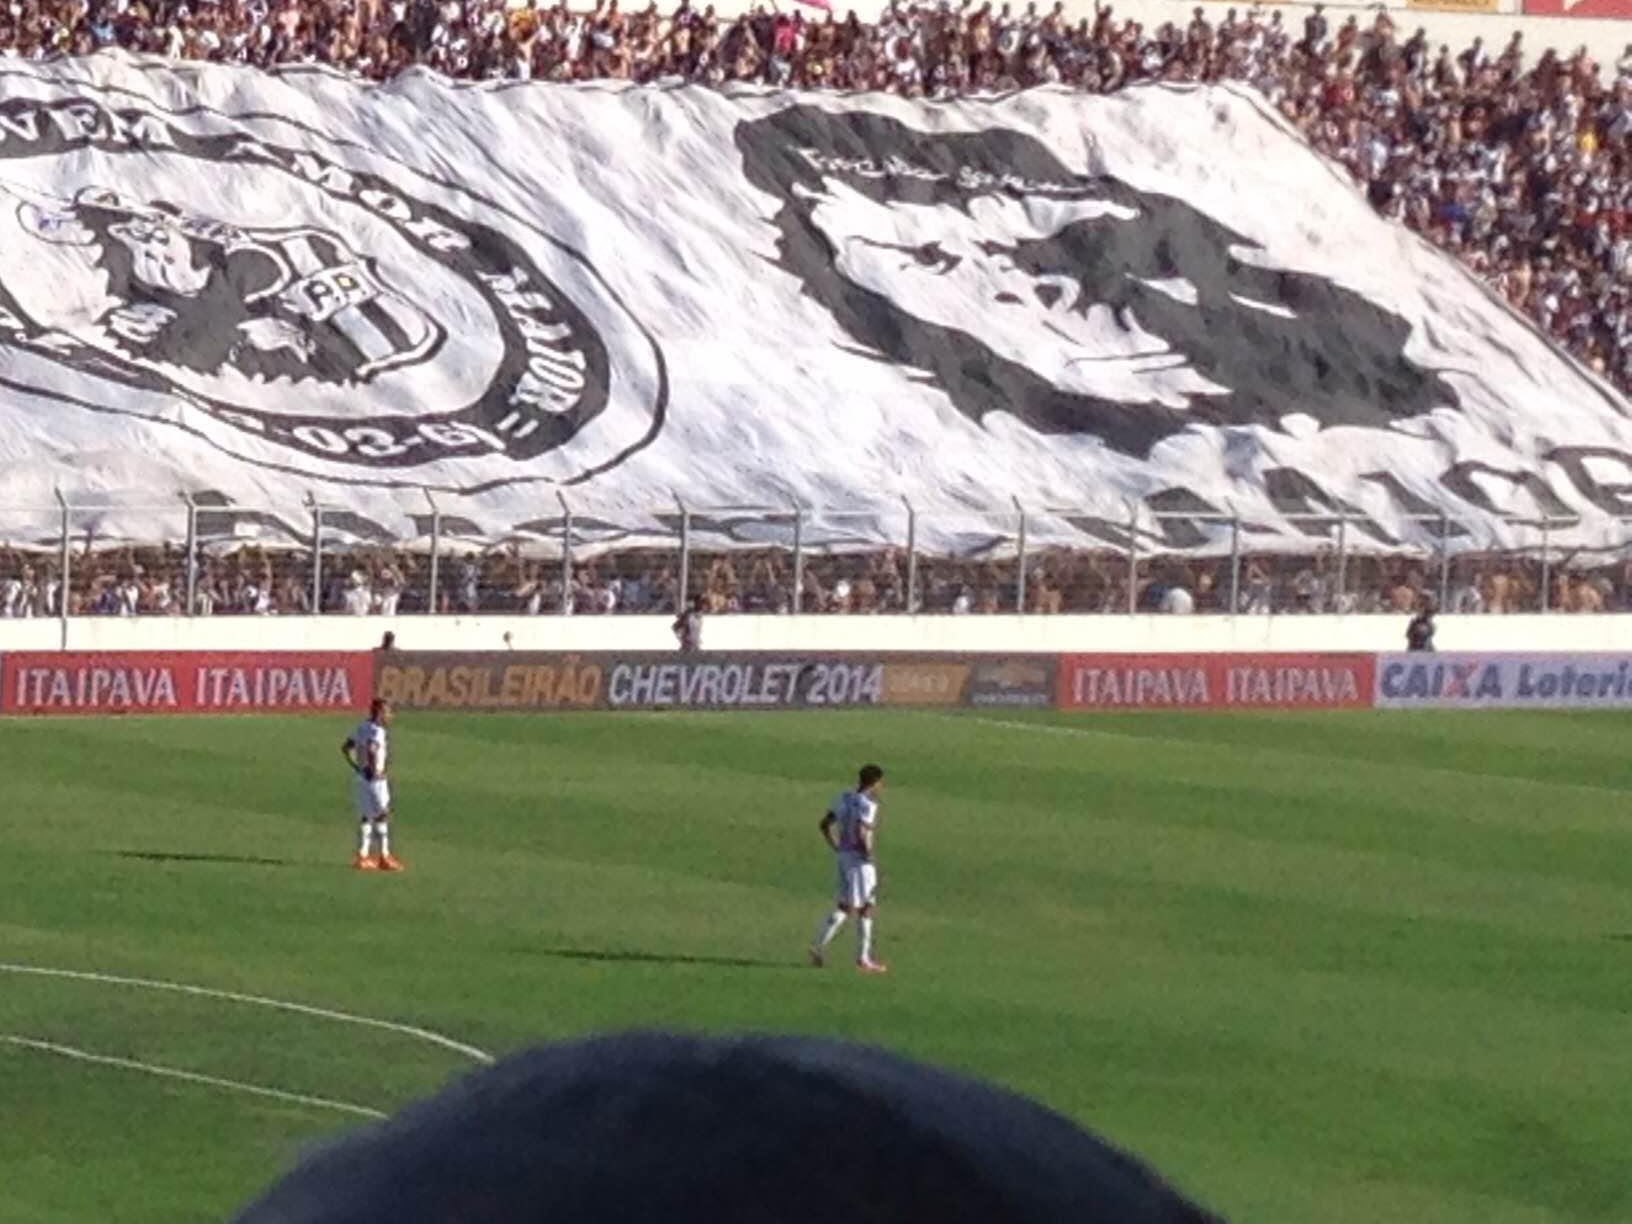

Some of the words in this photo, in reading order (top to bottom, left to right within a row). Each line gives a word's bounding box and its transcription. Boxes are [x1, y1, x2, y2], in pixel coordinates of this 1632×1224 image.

[15, 667, 177, 707] ITAIPAVA
[196, 667, 352, 706] ITAIPAVA
[379, 656, 603, 706] BRASILEIRÃO
[608, 664, 800, 704] CHEVROLET
[805, 664, 883, 704] 2014
[1074, 667, 1209, 705] ITAIPAVA
[1225, 667, 1359, 705] ITAIPAVA
[1381, 661, 1503, 699] CAIXA
